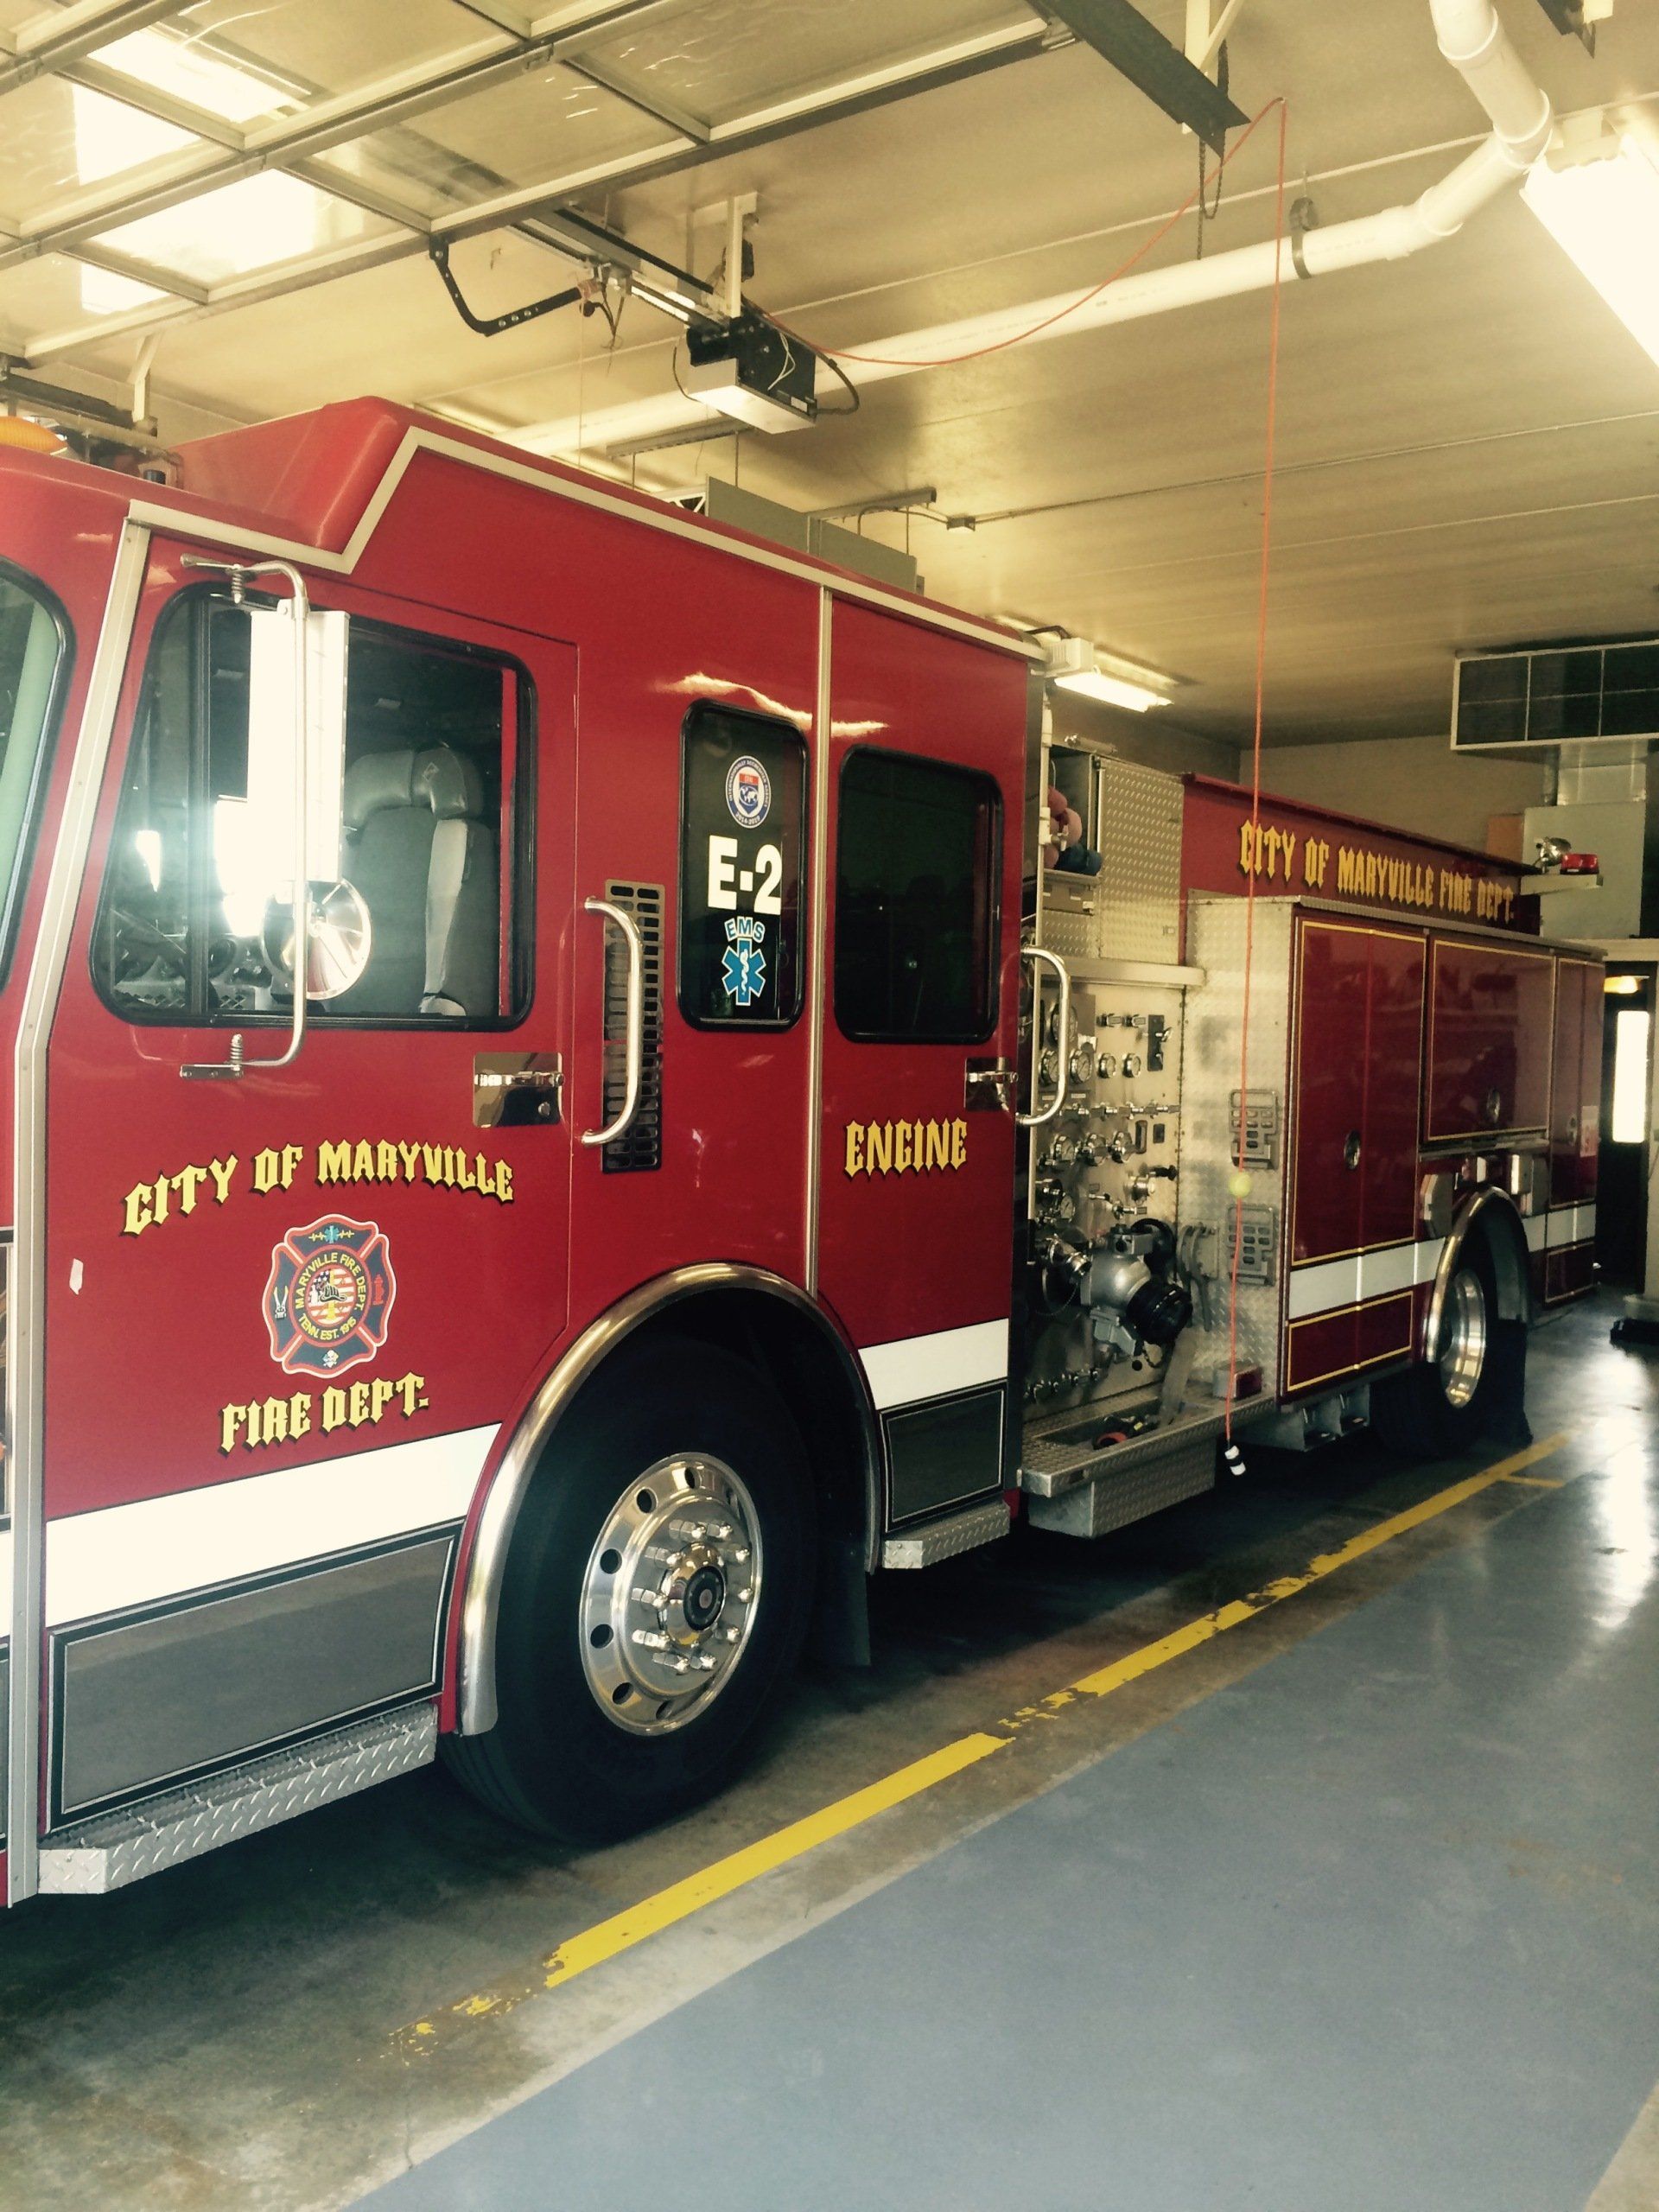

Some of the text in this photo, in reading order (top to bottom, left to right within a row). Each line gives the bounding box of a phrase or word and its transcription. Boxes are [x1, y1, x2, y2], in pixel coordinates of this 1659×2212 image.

[708, 835, 783, 916] E-2
[1239, 818, 1514, 924] CITY OF MARYVILLE FIRE DEPT.
[724, 916, 766, 943] EMS
[844, 1116, 968, 1179] ENGINE
[120, 1138, 516, 1236] CITY OF MARYVILLE
[295, 1252, 339, 1310] MARYVILLE
[340, 1253, 362, 1276] FIRE
[320, 1328, 340, 1341] EST.
[219, 1370, 429, 1456] FIRE DEPT.
